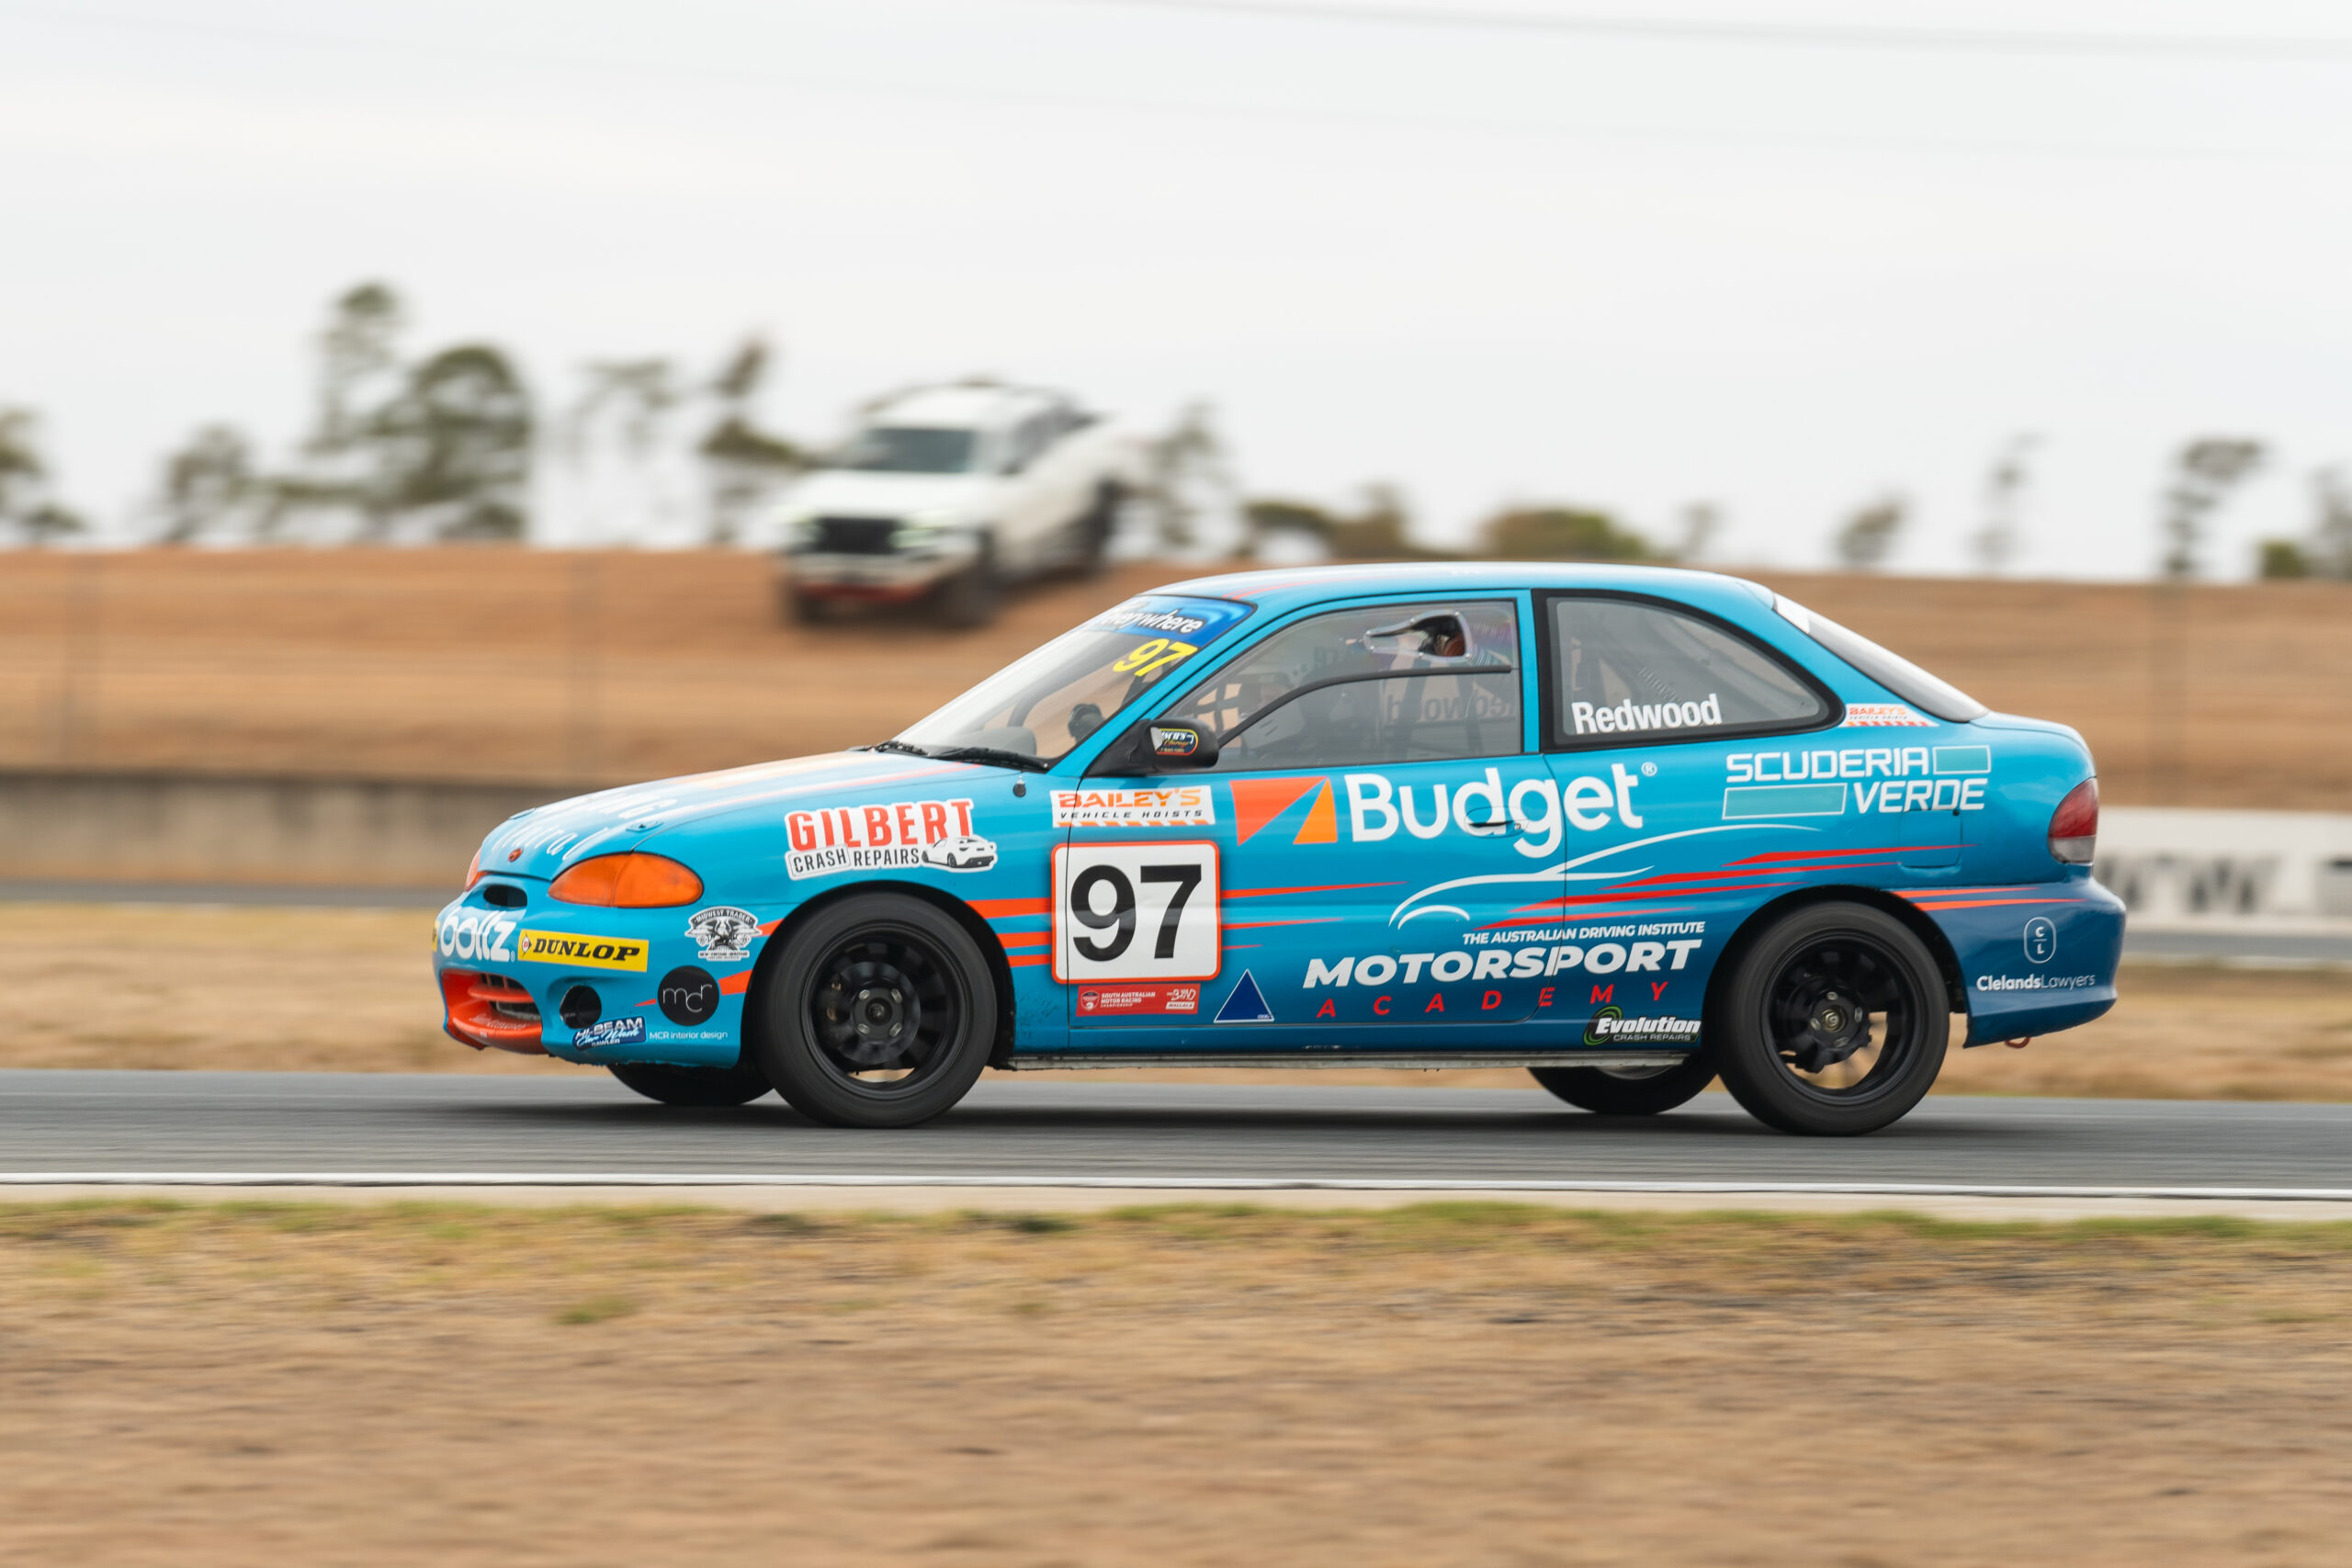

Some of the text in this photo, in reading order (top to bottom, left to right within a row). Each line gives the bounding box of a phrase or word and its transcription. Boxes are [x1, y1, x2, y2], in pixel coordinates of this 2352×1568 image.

[1112, 637, 1199, 677] 97
[1571, 693, 1723, 735] Redwood
[1725, 747, 1929, 783] SCUDERIA
[1057, 787, 1202, 808] BAILEY'S
[1852, 778, 1988, 814] VERDE
[1059, 809, 1204, 819] VEHICLE HOISTS
[1343, 762, 1644, 859] Budget
[787, 801, 970, 852] GILBERT
[793, 847, 920, 874] CRASH REPAIRS
[695, 908, 752, 923] MIDWEST TRADER
[1069, 863, 1203, 963] 97
[1462, 920, 1706, 945] THE AUSTRALIAN DRIVING INSTITUTE
[2035, 926, 2045, 938] C
[533, 938, 640, 961] DUNLOP
[2036, 943, 2046, 955] L
[1303, 939, 1703, 988] MOTORSPORT
[662, 983, 713, 1013] mcr
[1316, 981, 1668, 1018] ACADEMY
[649, 1030, 729, 1041] MCR interior design
[1595, 1016, 1702, 1035] Evolution
[1612, 1033, 1691, 1042] CRASH REPAIRS
